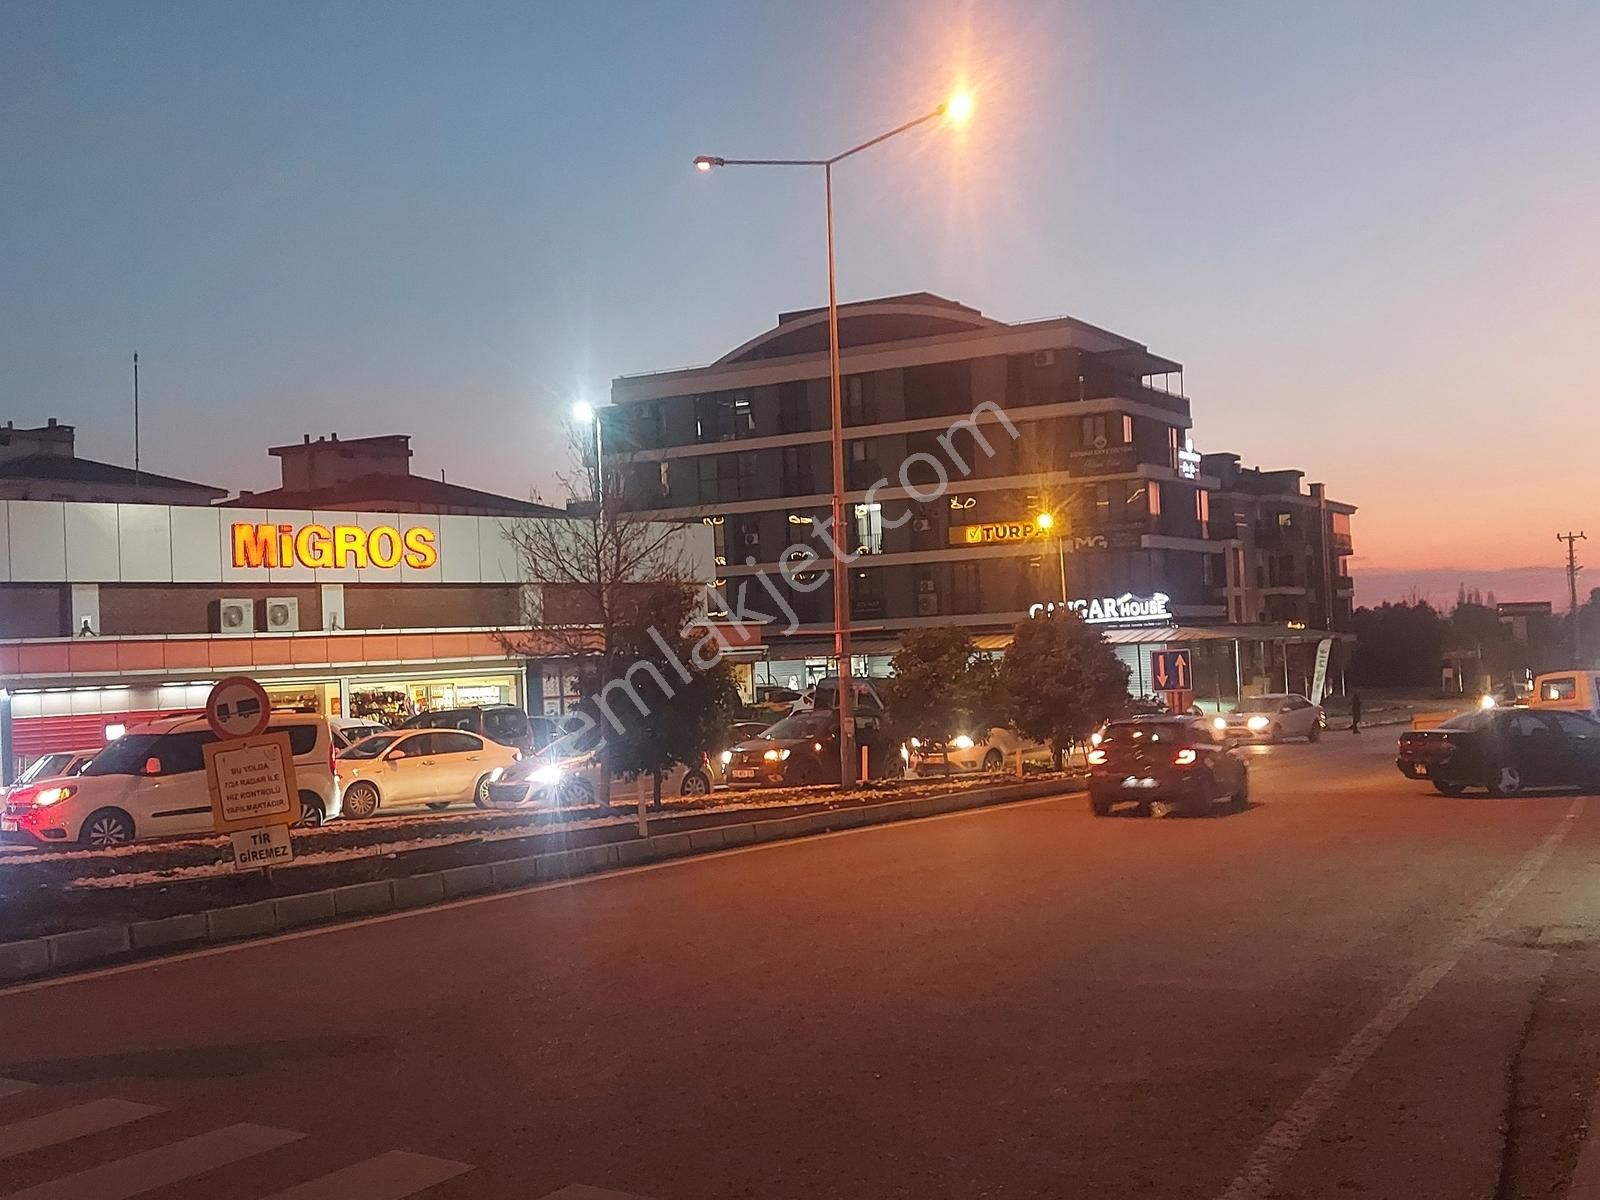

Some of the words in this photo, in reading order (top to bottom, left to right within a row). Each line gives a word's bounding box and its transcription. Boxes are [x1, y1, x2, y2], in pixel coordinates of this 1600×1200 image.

[1120, 600, 1167, 617] HOUSE
[251, 832, 271, 845] TİR
[239, 846, 288, 863] GİREMEZ
